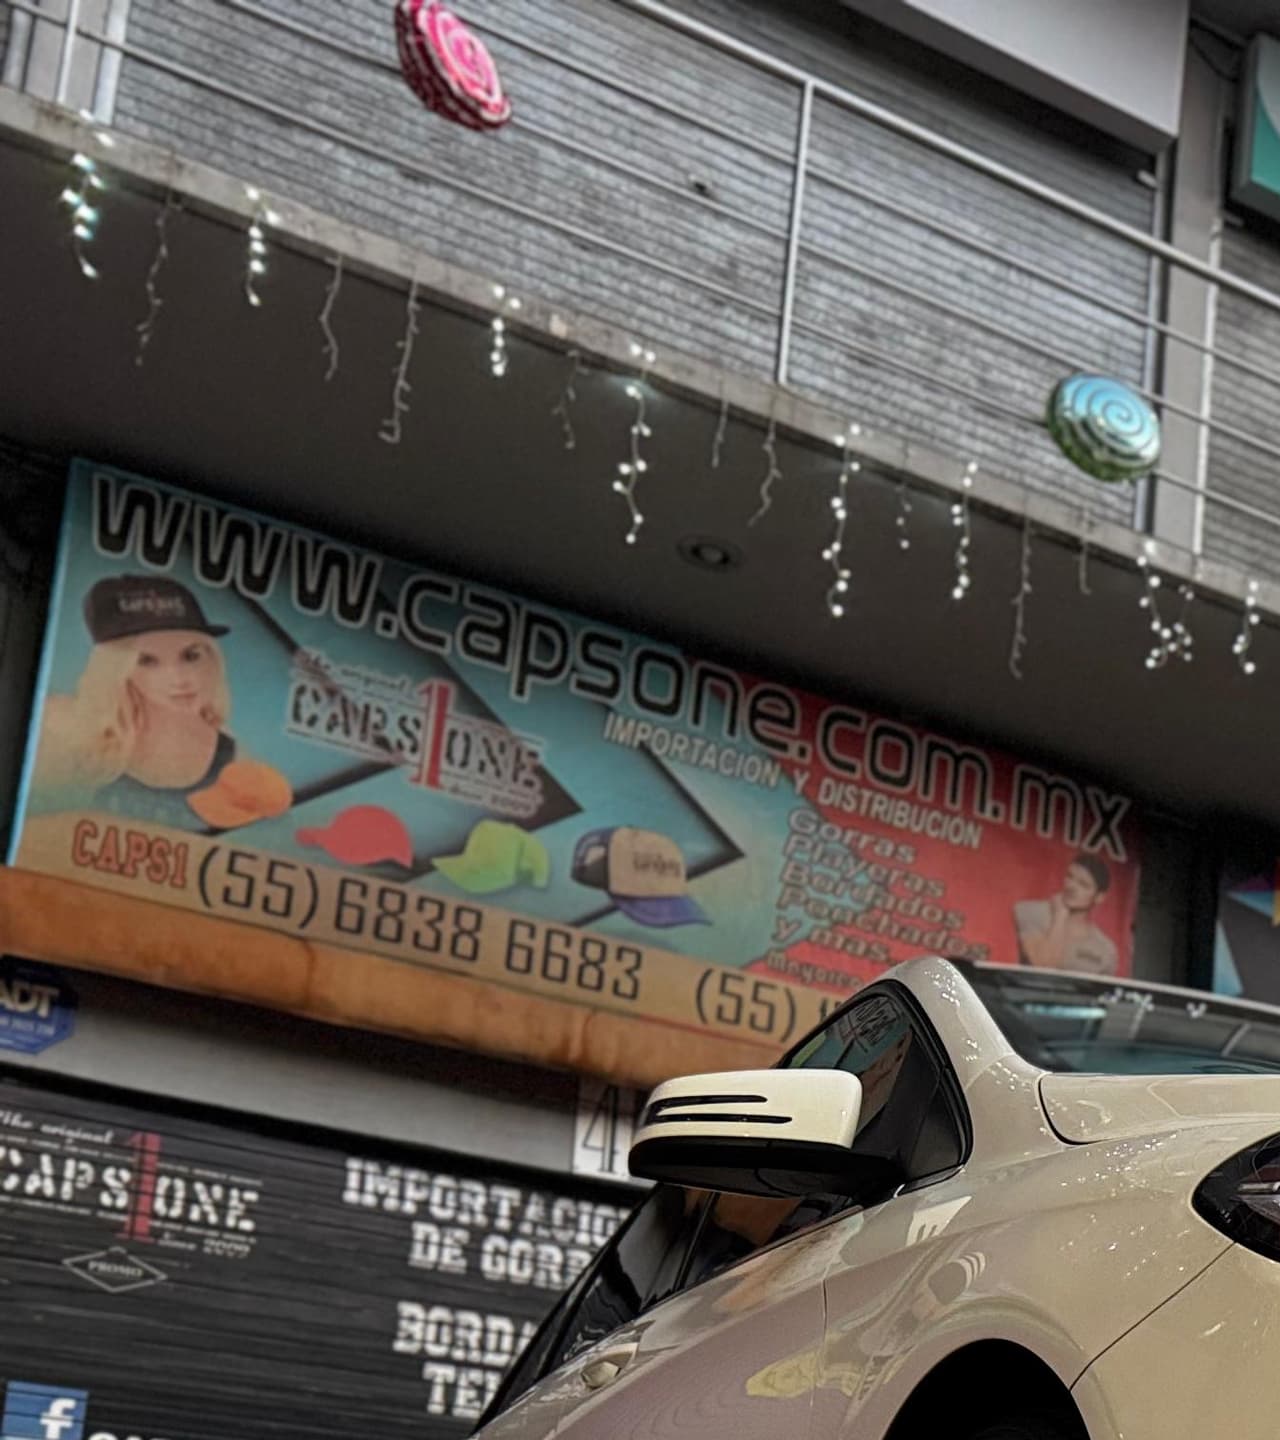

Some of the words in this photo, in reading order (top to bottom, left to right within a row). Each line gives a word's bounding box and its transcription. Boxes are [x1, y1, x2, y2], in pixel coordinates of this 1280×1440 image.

[92, 472, 1130, 863] www.capsone.com.mx
[605, 713, 781, 788] IMPORTACION
[793, 769, 810, 795] Y
[783, 833, 946, 899] Playeras
[788, 807, 918, 866] Gorras
[776, 886, 990, 962] Ponchados
[780, 860, 965, 931] Bordados
[71, 820, 189, 889] CAPS1
[199, 845, 321, 929] (55)
[334, 877, 484, 964] 6838
[504, 914, 644, 1001] 6683
[695, 967, 797, 1043] (55)
[87, 1259, 145, 1280] PROMO
[408, 1221, 471, 1275] DE
